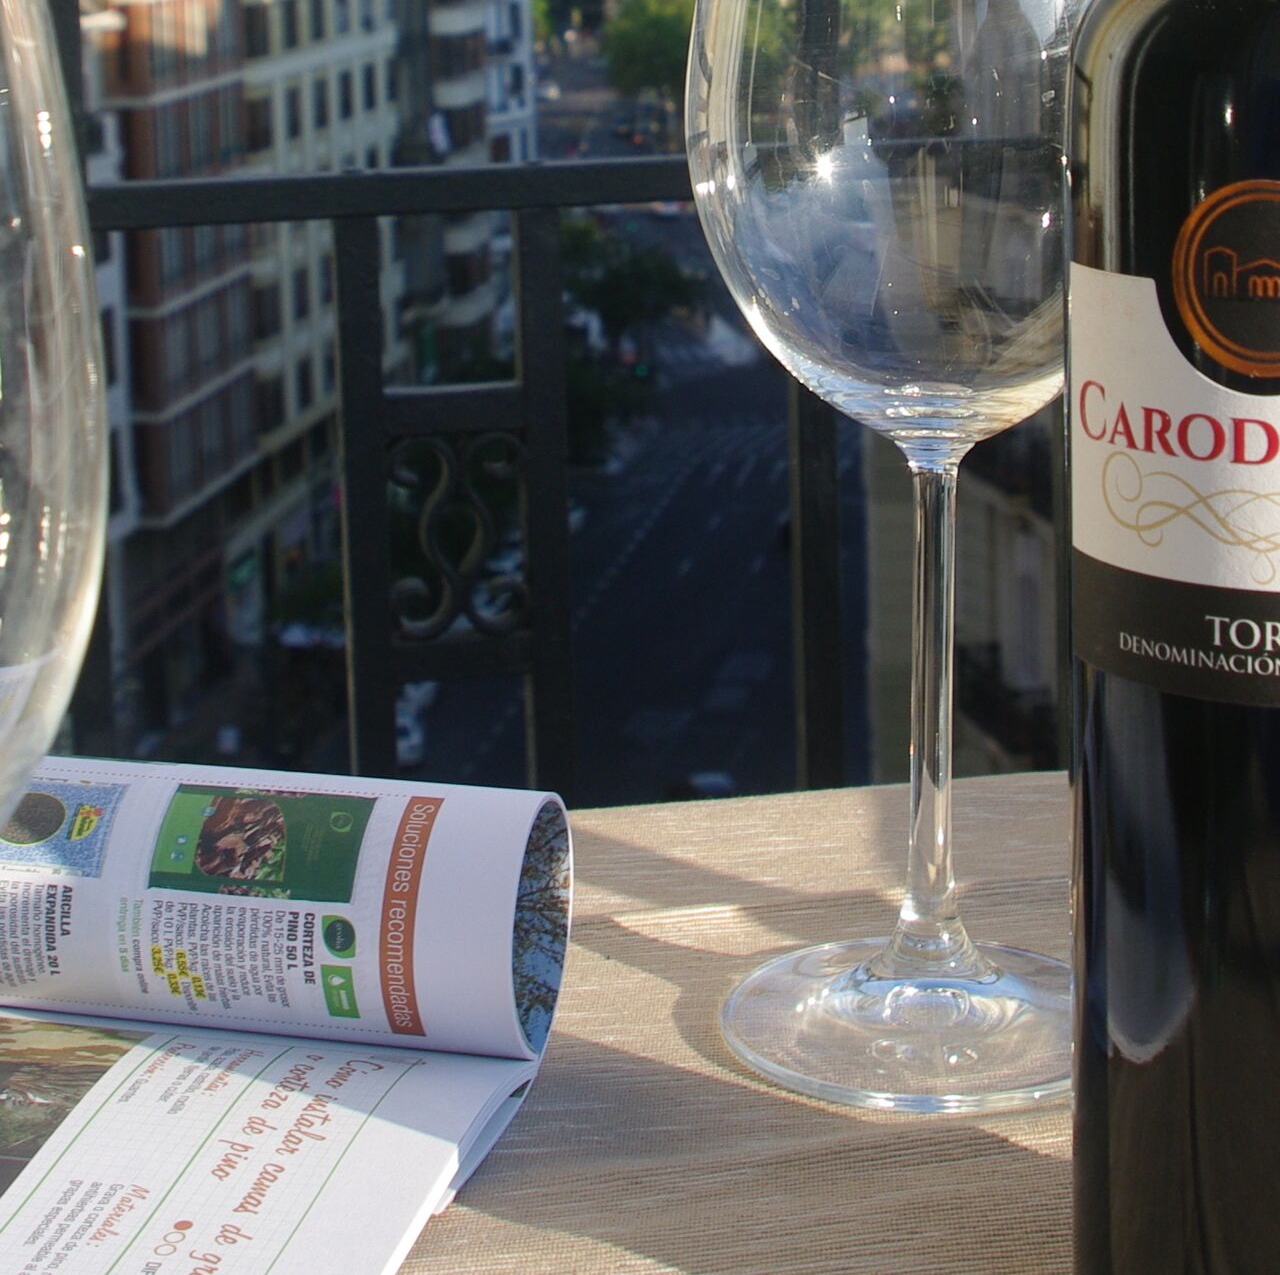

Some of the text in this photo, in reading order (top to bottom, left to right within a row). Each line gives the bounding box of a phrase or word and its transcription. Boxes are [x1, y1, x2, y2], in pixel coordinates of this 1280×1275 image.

[0, 882, 9, 902] Evita
[22, 883, 33, 935] Incrementa
[36, 886, 44, 921] Tamaño
[61, 886, 72, 935] ARCILLA
[164, 901, 174, 927] de 10
[8, 894, 20, 939] porosidad
[47, 885, 60, 967] EXPANDIDA 20
[200, 904, 211, 956] Acolcha las
[213, 905, 222, 961] aparición de
[225, 918, 235, 950] erosión
[238, 908, 246, 962] evaporación
[262, 912, 272, 937] 100%
[288, 912, 299, 941] PINO
[387, 804, 435, 1028] Soluciones recomendadas
[10, 942, 21, 955] del
[133, 940, 144, 971] compra
[225, 954, 236, 967] del
[250, 909, 260, 983] pérdidas de agua
[274, 911, 286, 974] De 15-25 mm
[286, 947, 297, 960] 50
[304, 914, 316, 984] CORTEZA DE
[325, 1060, 384, 1089] Cómo
[211, 1064, 315, 1181] corteza de pino
[275, 1093, 338, 1154] instalar
[57, 1180, 83, 1205] grapas
[232, 1163, 285, 1214] camas
[62, 1184, 123, 1251] Grava corteza de
[215, 1224, 253, 1245] de
[32, 1223, 70, 1262] permeable
